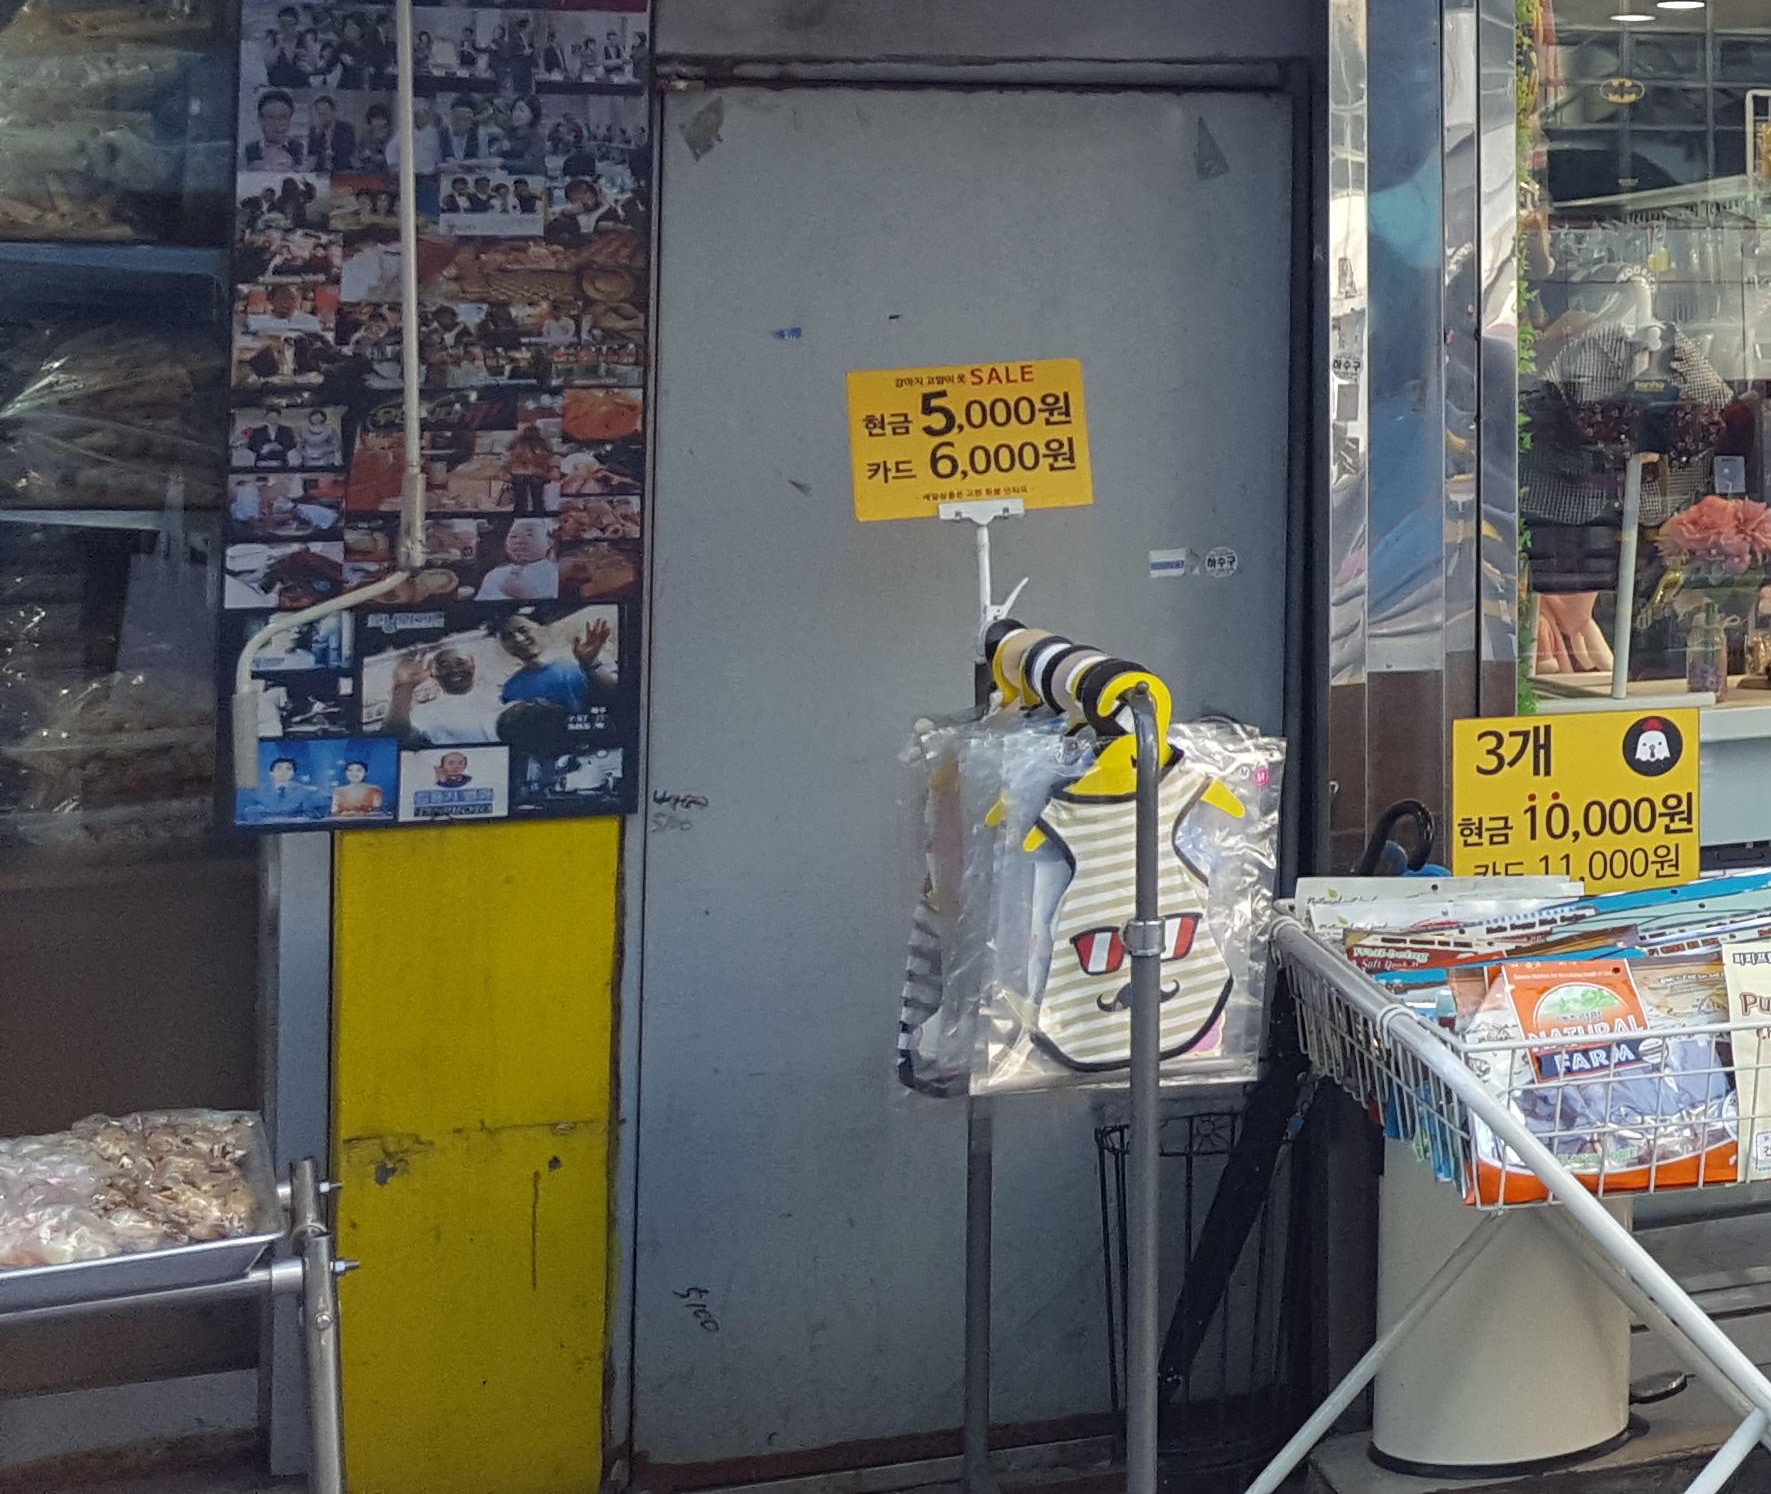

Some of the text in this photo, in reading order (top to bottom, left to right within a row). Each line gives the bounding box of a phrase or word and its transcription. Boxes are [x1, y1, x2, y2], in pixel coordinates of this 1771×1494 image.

[970, 364, 1035, 386] SALE
[863, 390, 1073, 437] 현금 5,000원
[867, 436, 1077, 484] 카드 6,000원
[1476, 724, 1552, 777] 3개
[1458, 792, 1694, 847] 현금 10,000원
[1538, 843, 1681, 882] 11,000원
[1528, 1015, 1645, 1052] NATURAL
[1554, 1044, 1635, 1073] FARM
